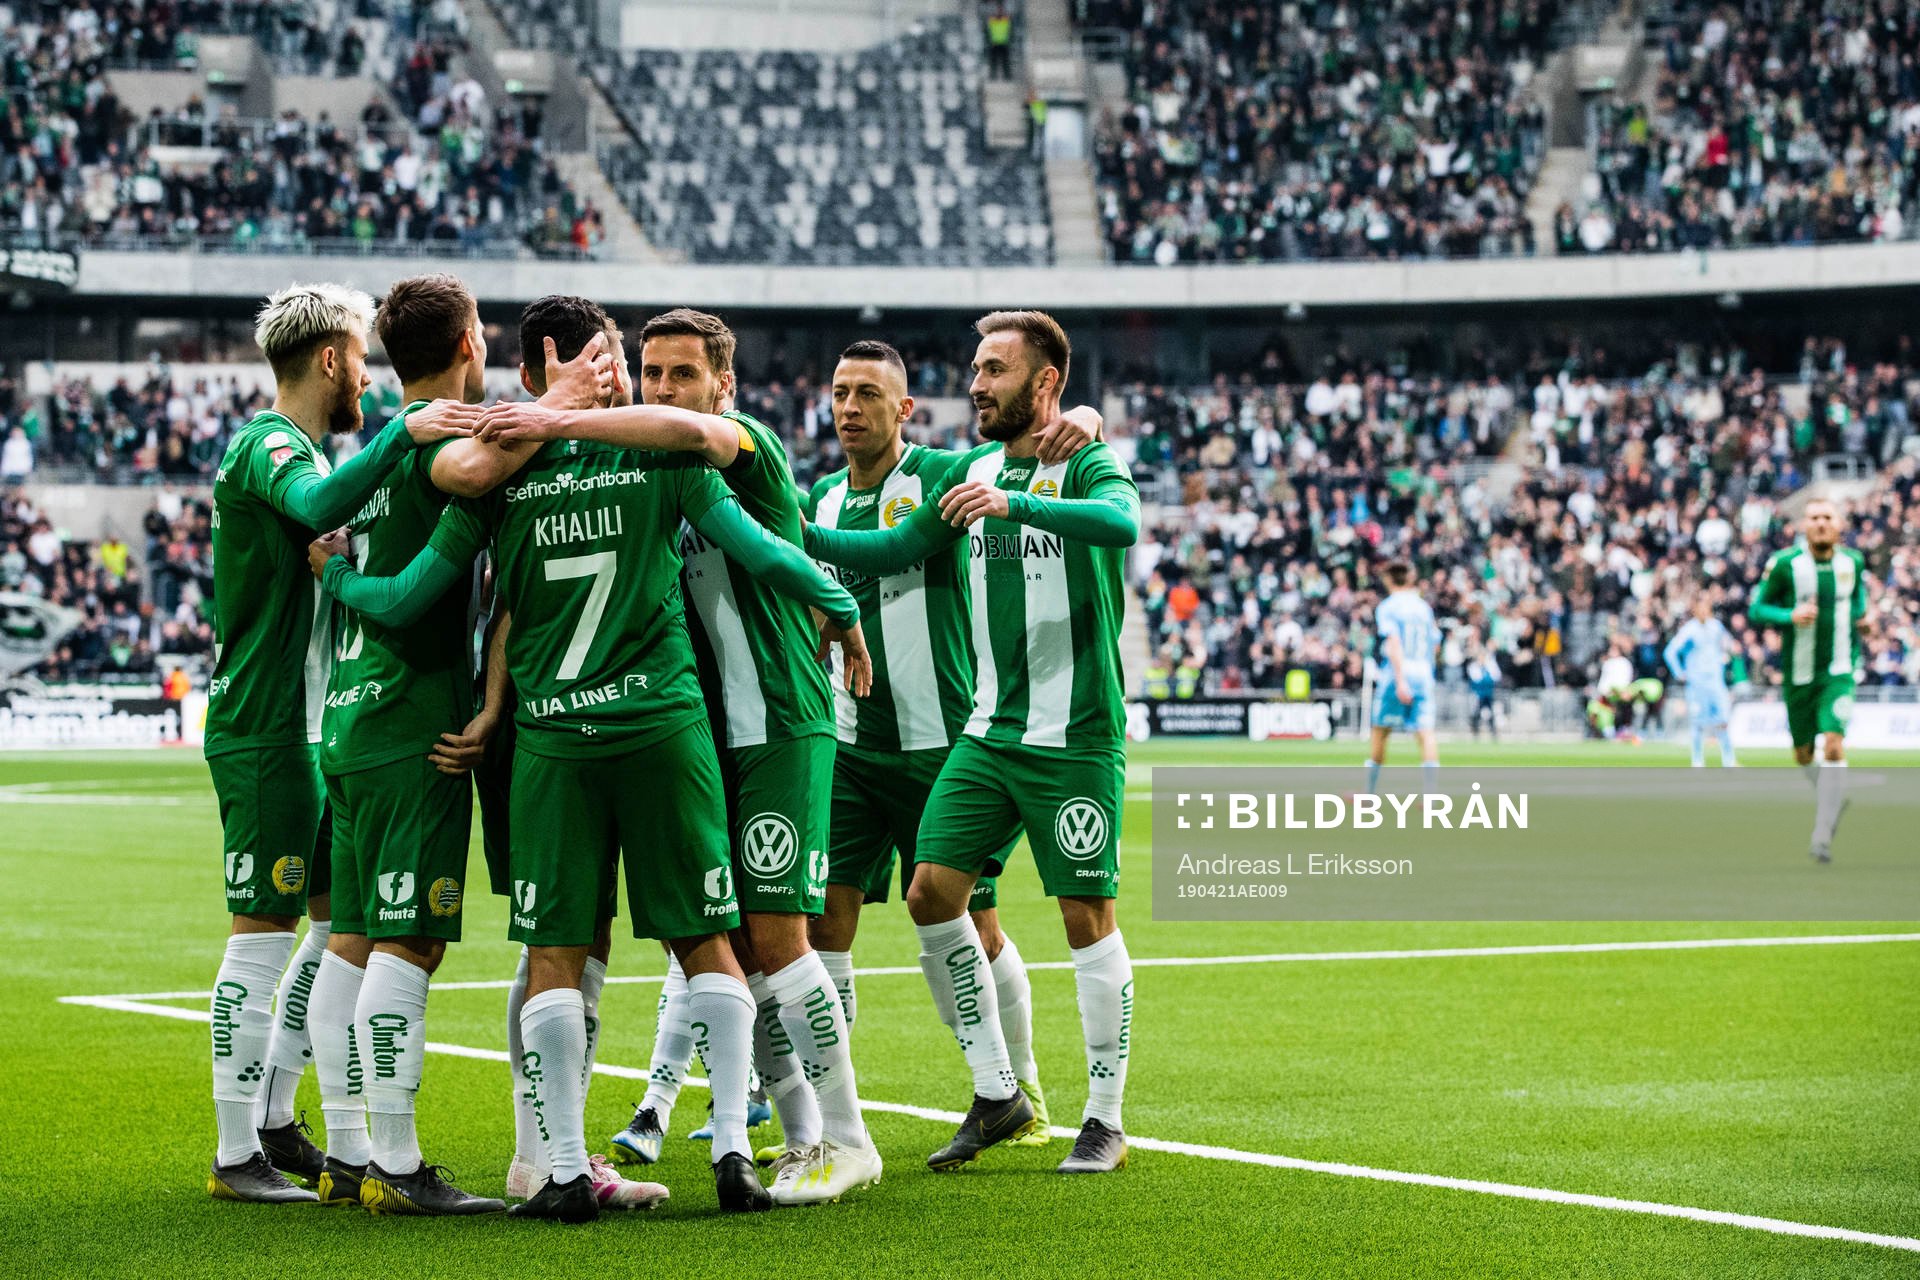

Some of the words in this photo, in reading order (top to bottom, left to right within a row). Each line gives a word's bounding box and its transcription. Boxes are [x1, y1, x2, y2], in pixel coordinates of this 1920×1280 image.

[505, 480, 561, 503] Sefina
[570, 468, 647, 495] pantbank
[535, 505, 623, 546] KHALILI
[970, 534, 1063, 559] OBMAN
[544, 551, 618, 680] 7
[571, 683, 621, 709] LINE
[757, 885, 788, 894] CRAFT
[379, 907, 416, 921] fronta
[946, 945, 983, 1026] Clinton
[213, 981, 248, 1057] Clinton
[369, 1013, 408, 1078] Clinton
